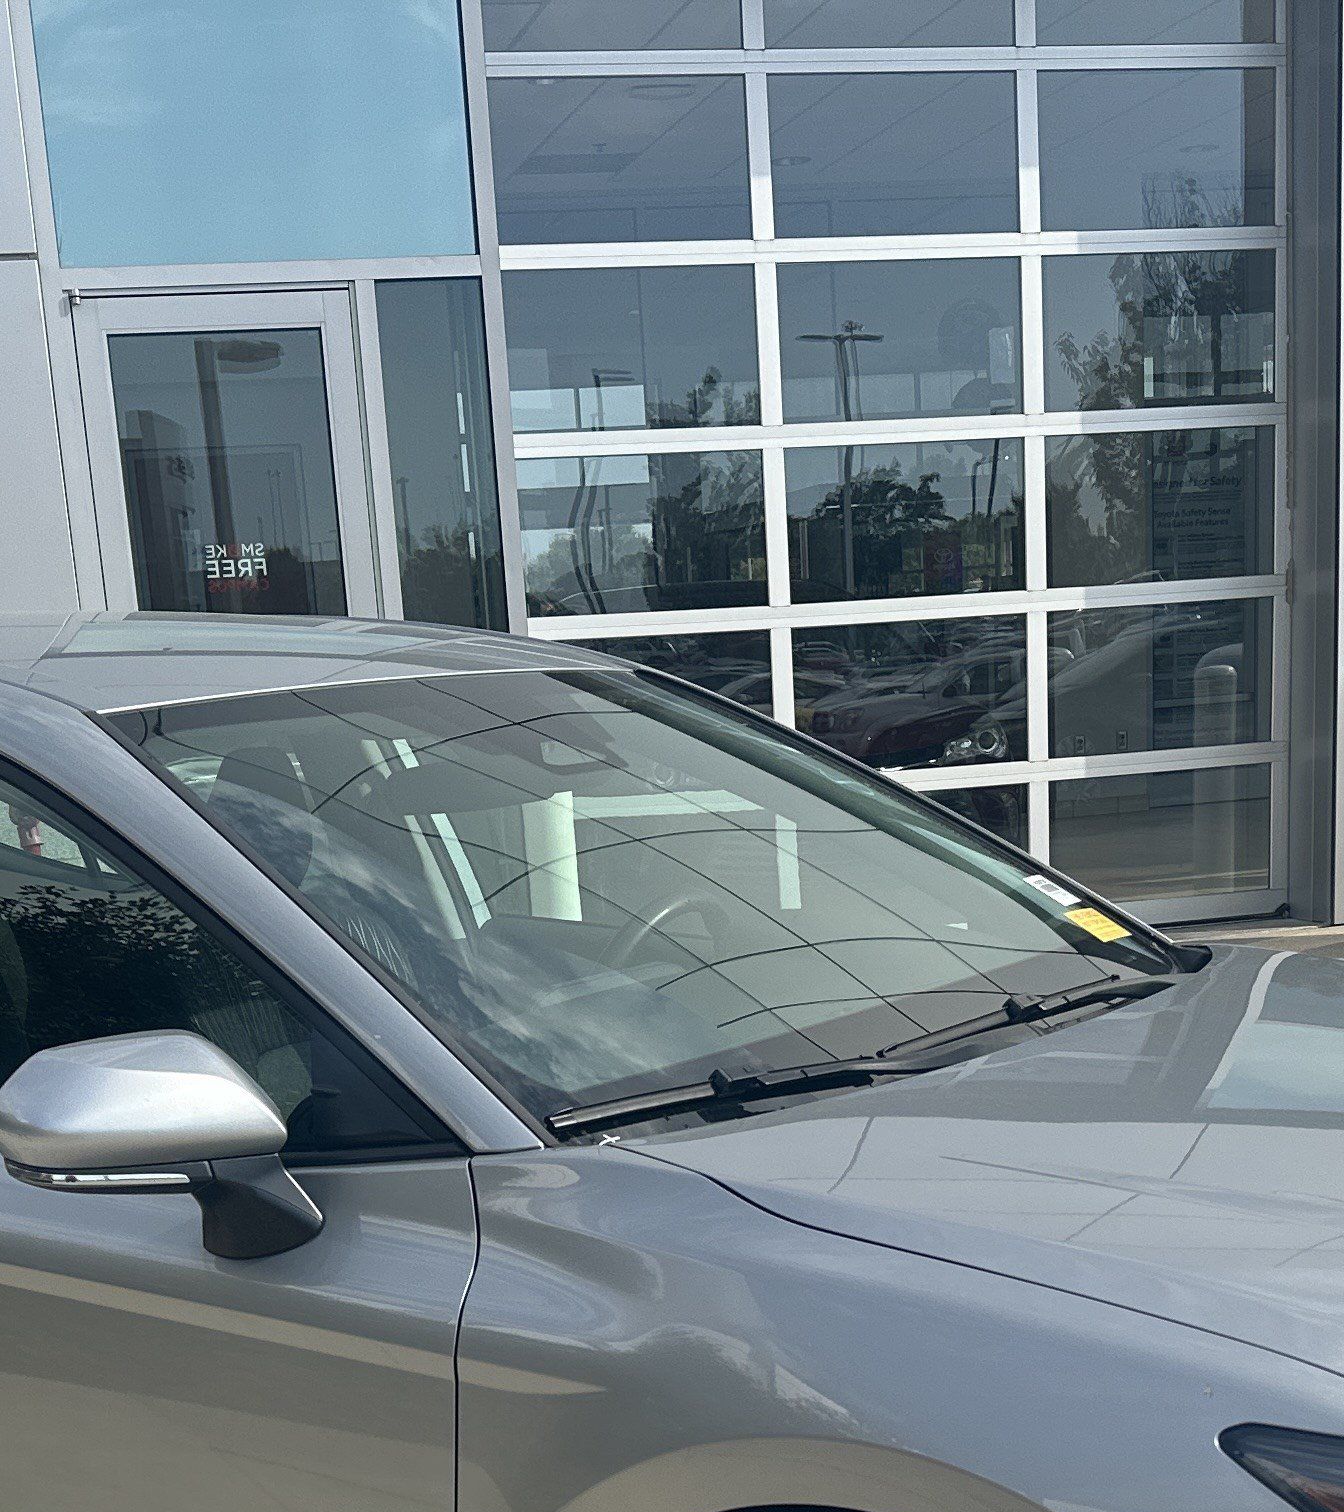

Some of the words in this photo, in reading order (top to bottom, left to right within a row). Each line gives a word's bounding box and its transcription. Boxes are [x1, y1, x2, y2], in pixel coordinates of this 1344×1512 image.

[1211, 476, 1240, 487] Safety
[1182, 507, 1206, 518] Safety
[1207, 506, 1231, 516] Sense
